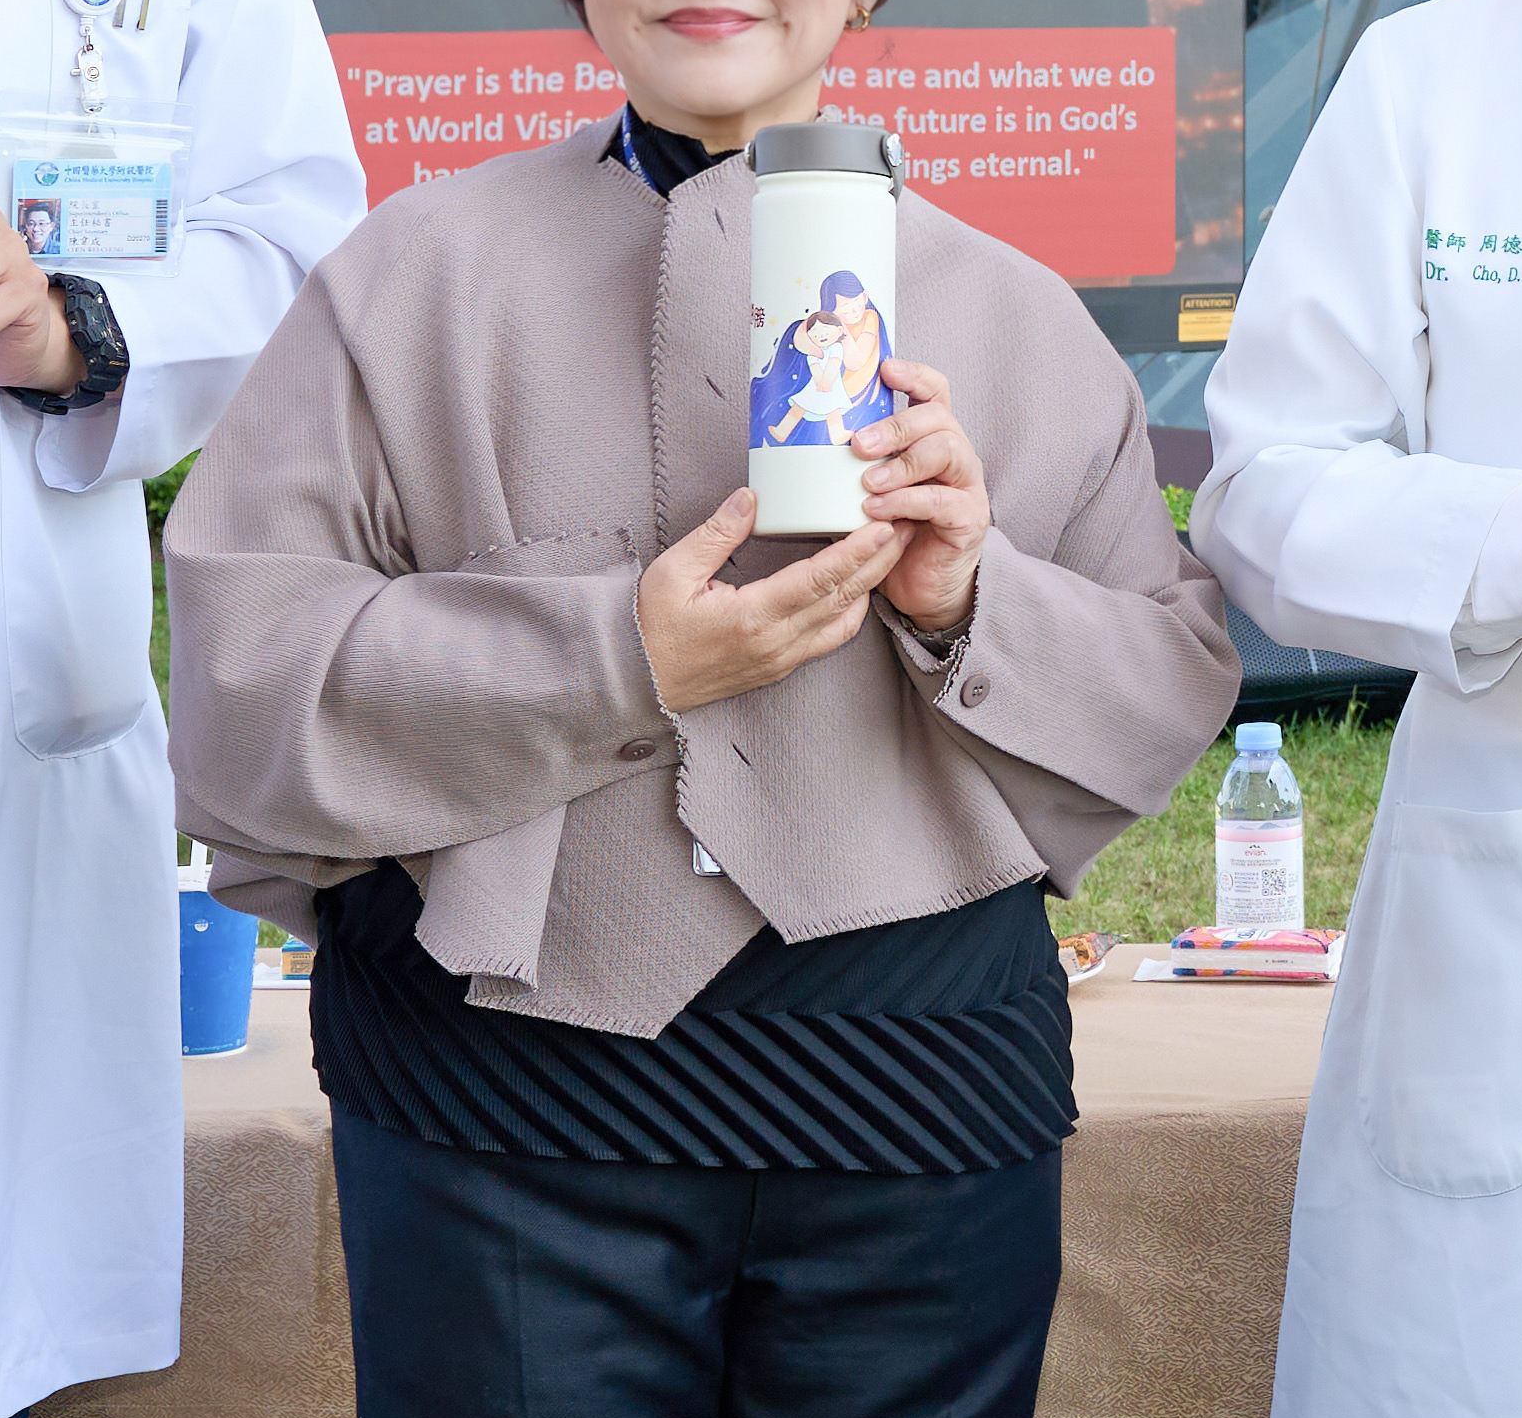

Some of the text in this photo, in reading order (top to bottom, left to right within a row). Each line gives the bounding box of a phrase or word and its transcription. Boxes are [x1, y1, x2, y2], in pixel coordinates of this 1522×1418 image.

[347, 67, 466, 102] "Prayer
[476, 67, 500, 96] is
[509, 64, 565, 94] the
[866, 67, 916, 89] are
[924, 61, 980, 89] and
[989, 61, 1062, 88] what
[1070, 65, 1111, 87] we
[1118, 60, 1155, 87] do
[365, 120, 398, 144] at
[405, 113, 503, 144] World
[514, 110, 602, 141] Visi
[894, 105, 986, 134] future
[995, 105, 1017, 133] is
[1025, 105, 1052, 132] in
[904, 151, 960, 185] ings
[969, 148, 1096, 179] eternal."
[1425, 228, 1466, 253] 醫師
[1425, 261, 1448, 281] Dr.
[1473, 265, 1501, 284] Cho,
[1508, 267, 1520, 282] D.
